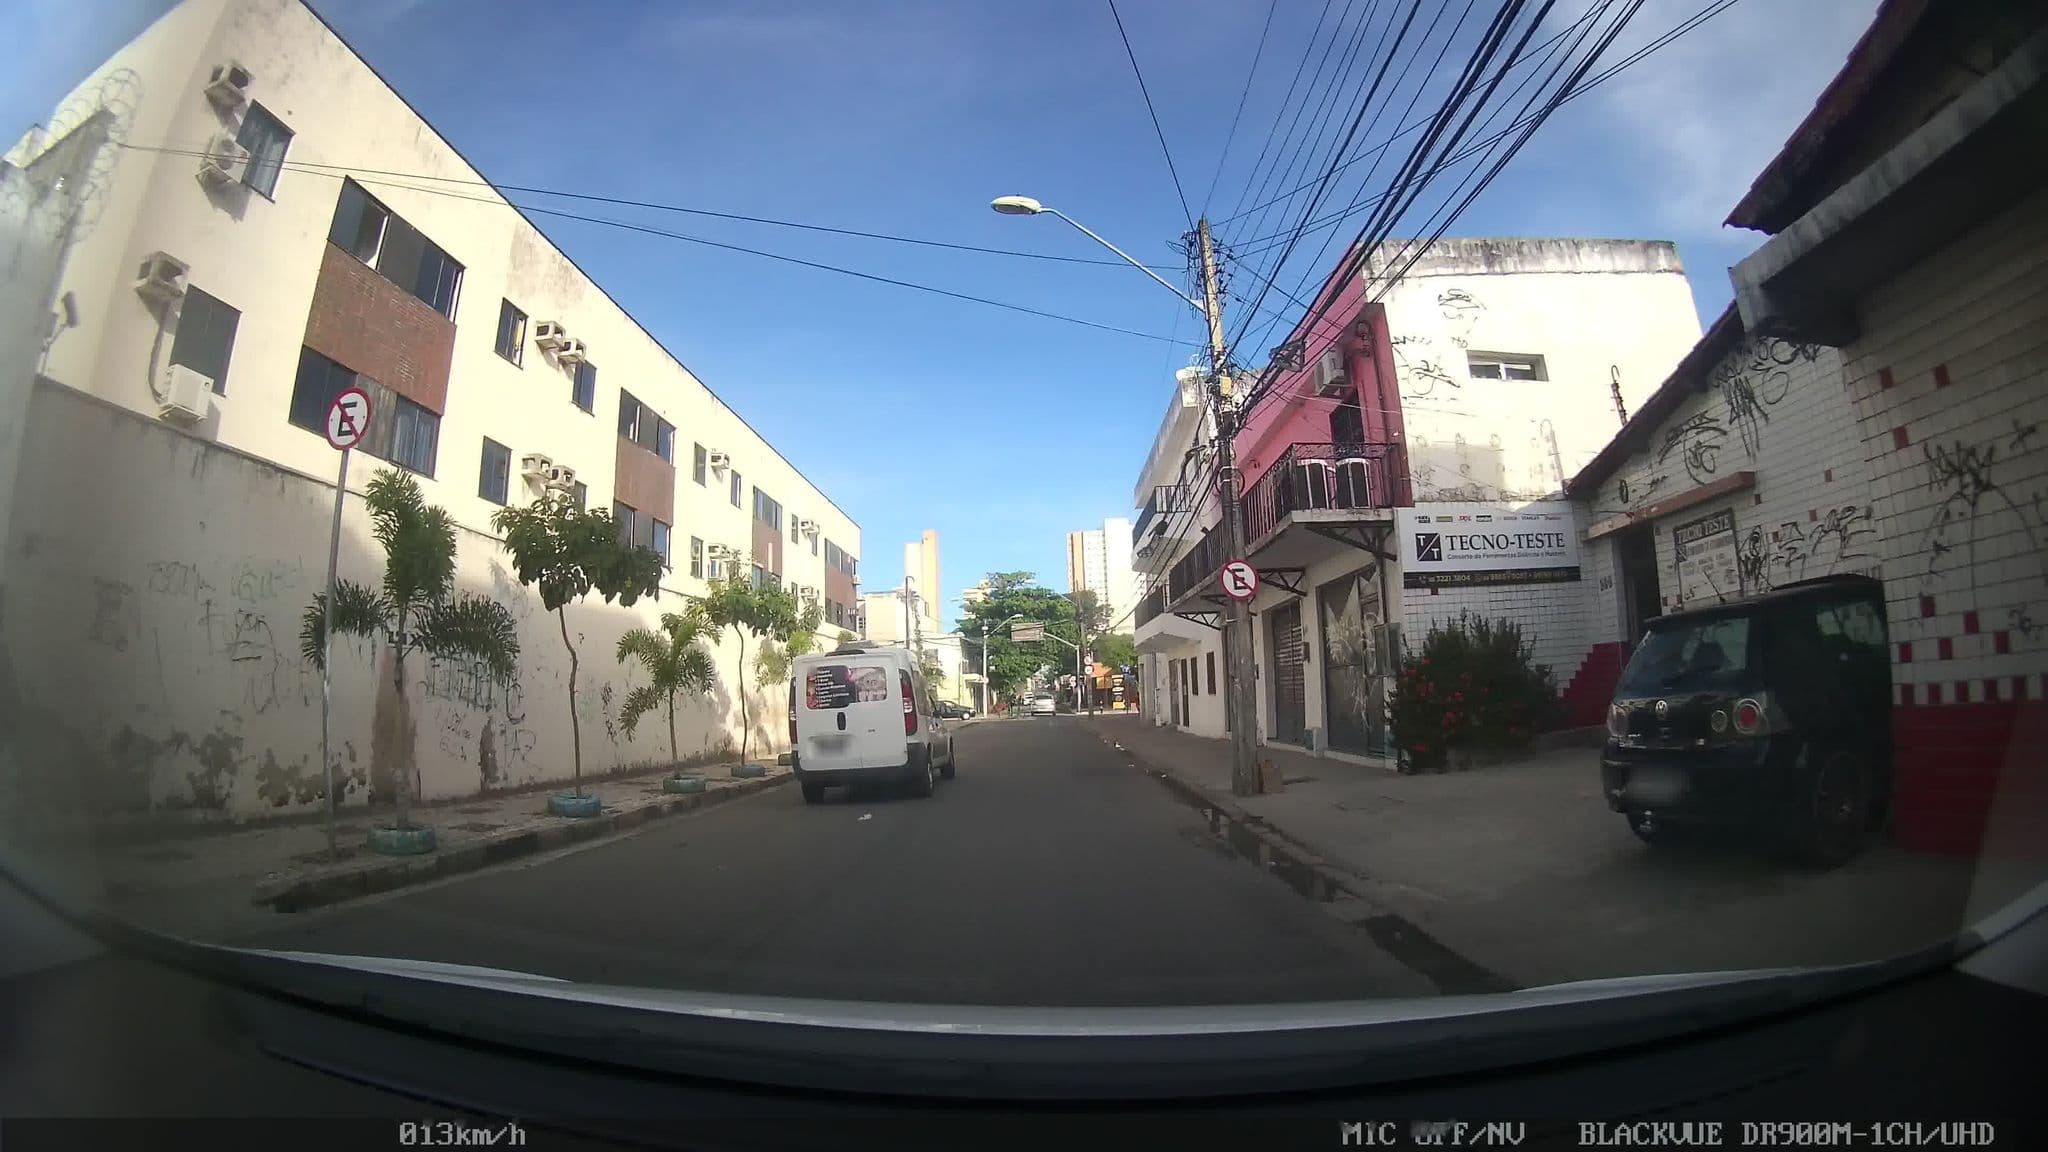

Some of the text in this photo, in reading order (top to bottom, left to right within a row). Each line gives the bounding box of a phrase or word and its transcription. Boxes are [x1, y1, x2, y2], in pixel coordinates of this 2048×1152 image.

[337, 401, 358, 437] E
[1445, 533, 1565, 550] TECNO-TESTE
[1232, 568, 1249, 590] E
